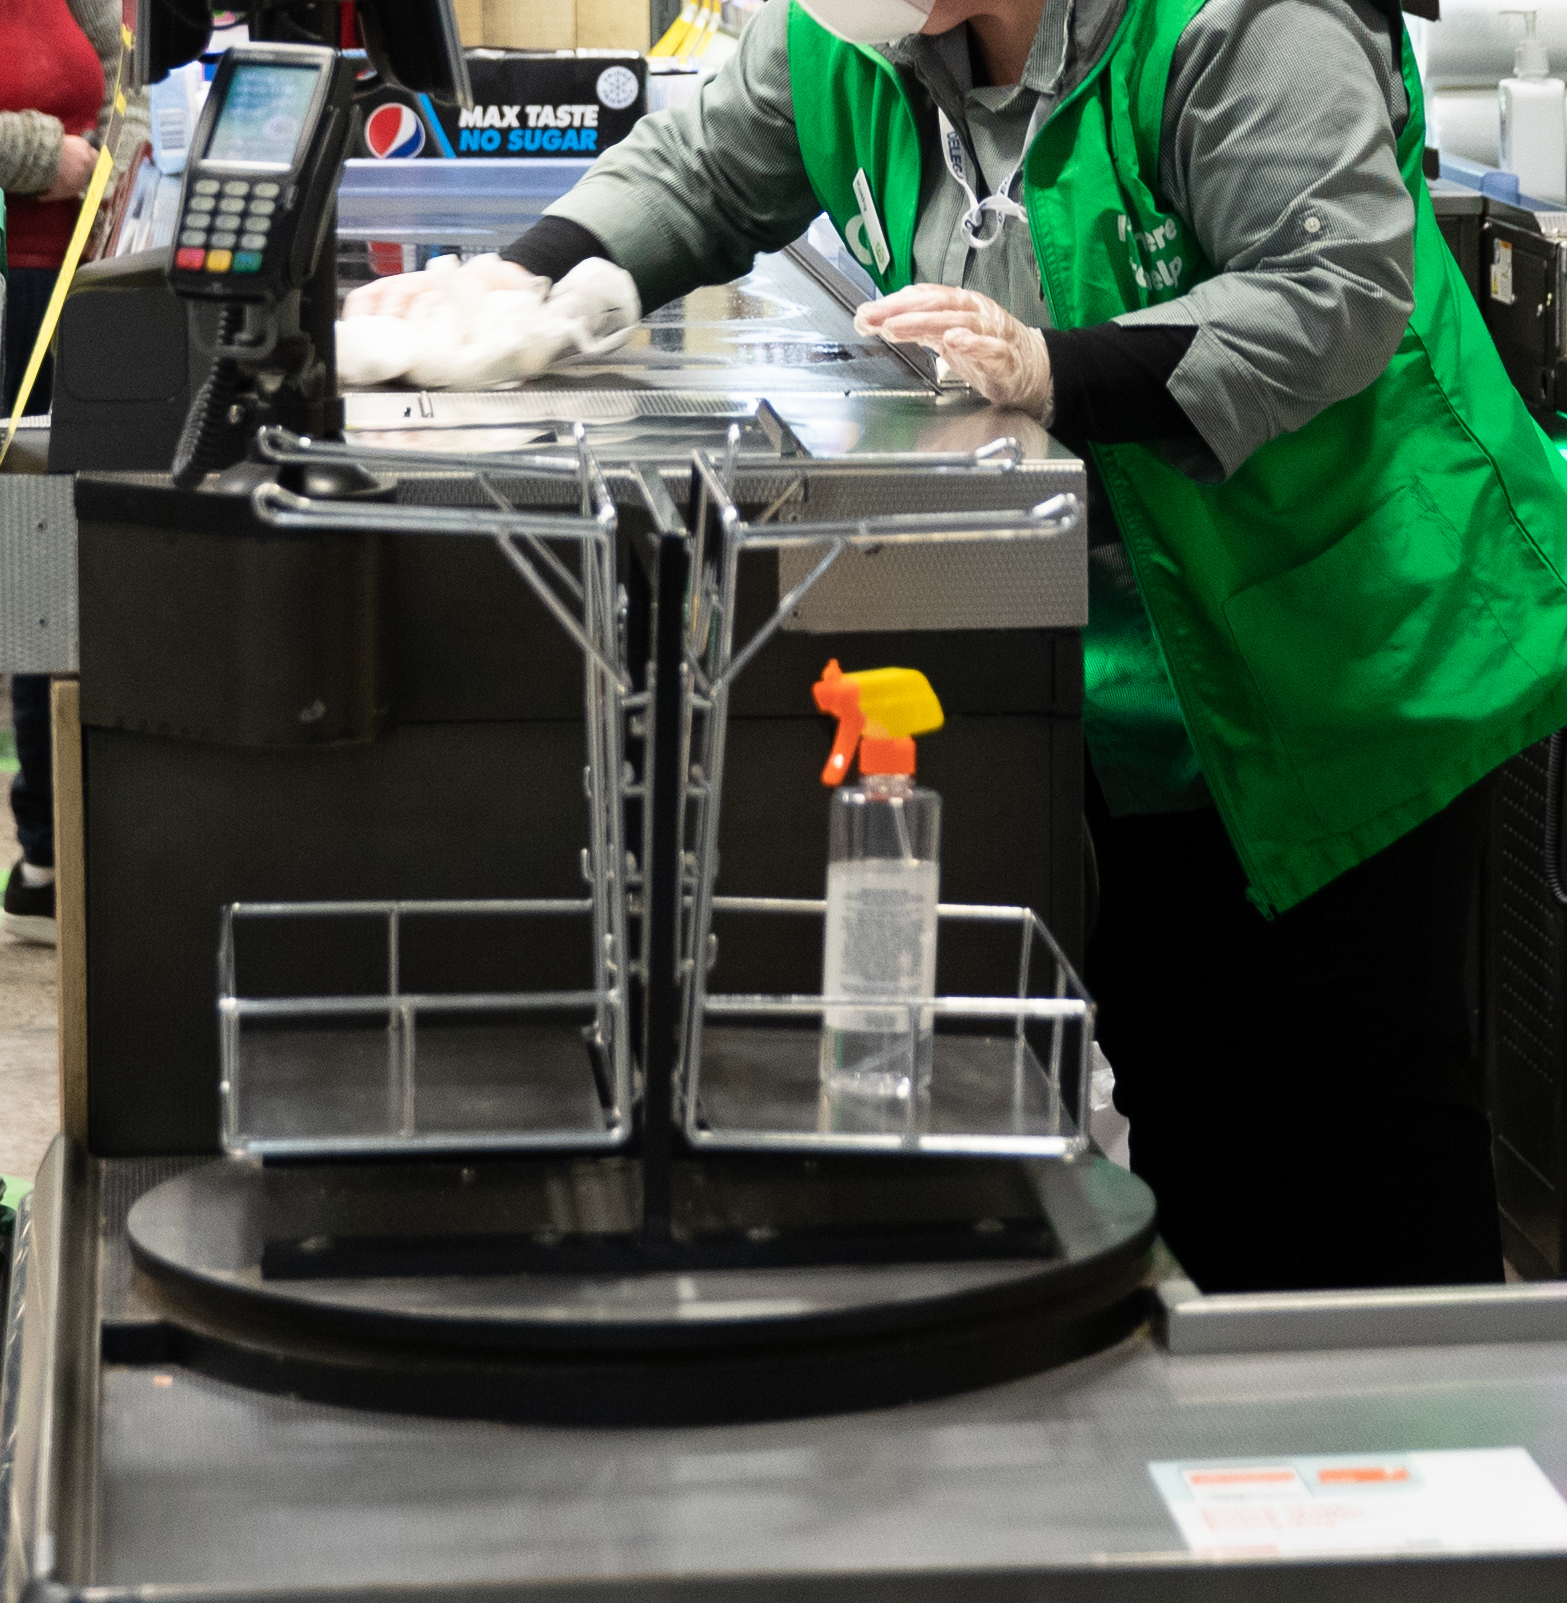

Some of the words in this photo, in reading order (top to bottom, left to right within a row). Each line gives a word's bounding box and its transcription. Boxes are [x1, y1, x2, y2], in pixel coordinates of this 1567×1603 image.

[459, 105, 521, 128] MAX
[525, 105, 600, 128] TASTE
[459, 129, 502, 151] NO
[506, 129, 598, 151] SUGAR
